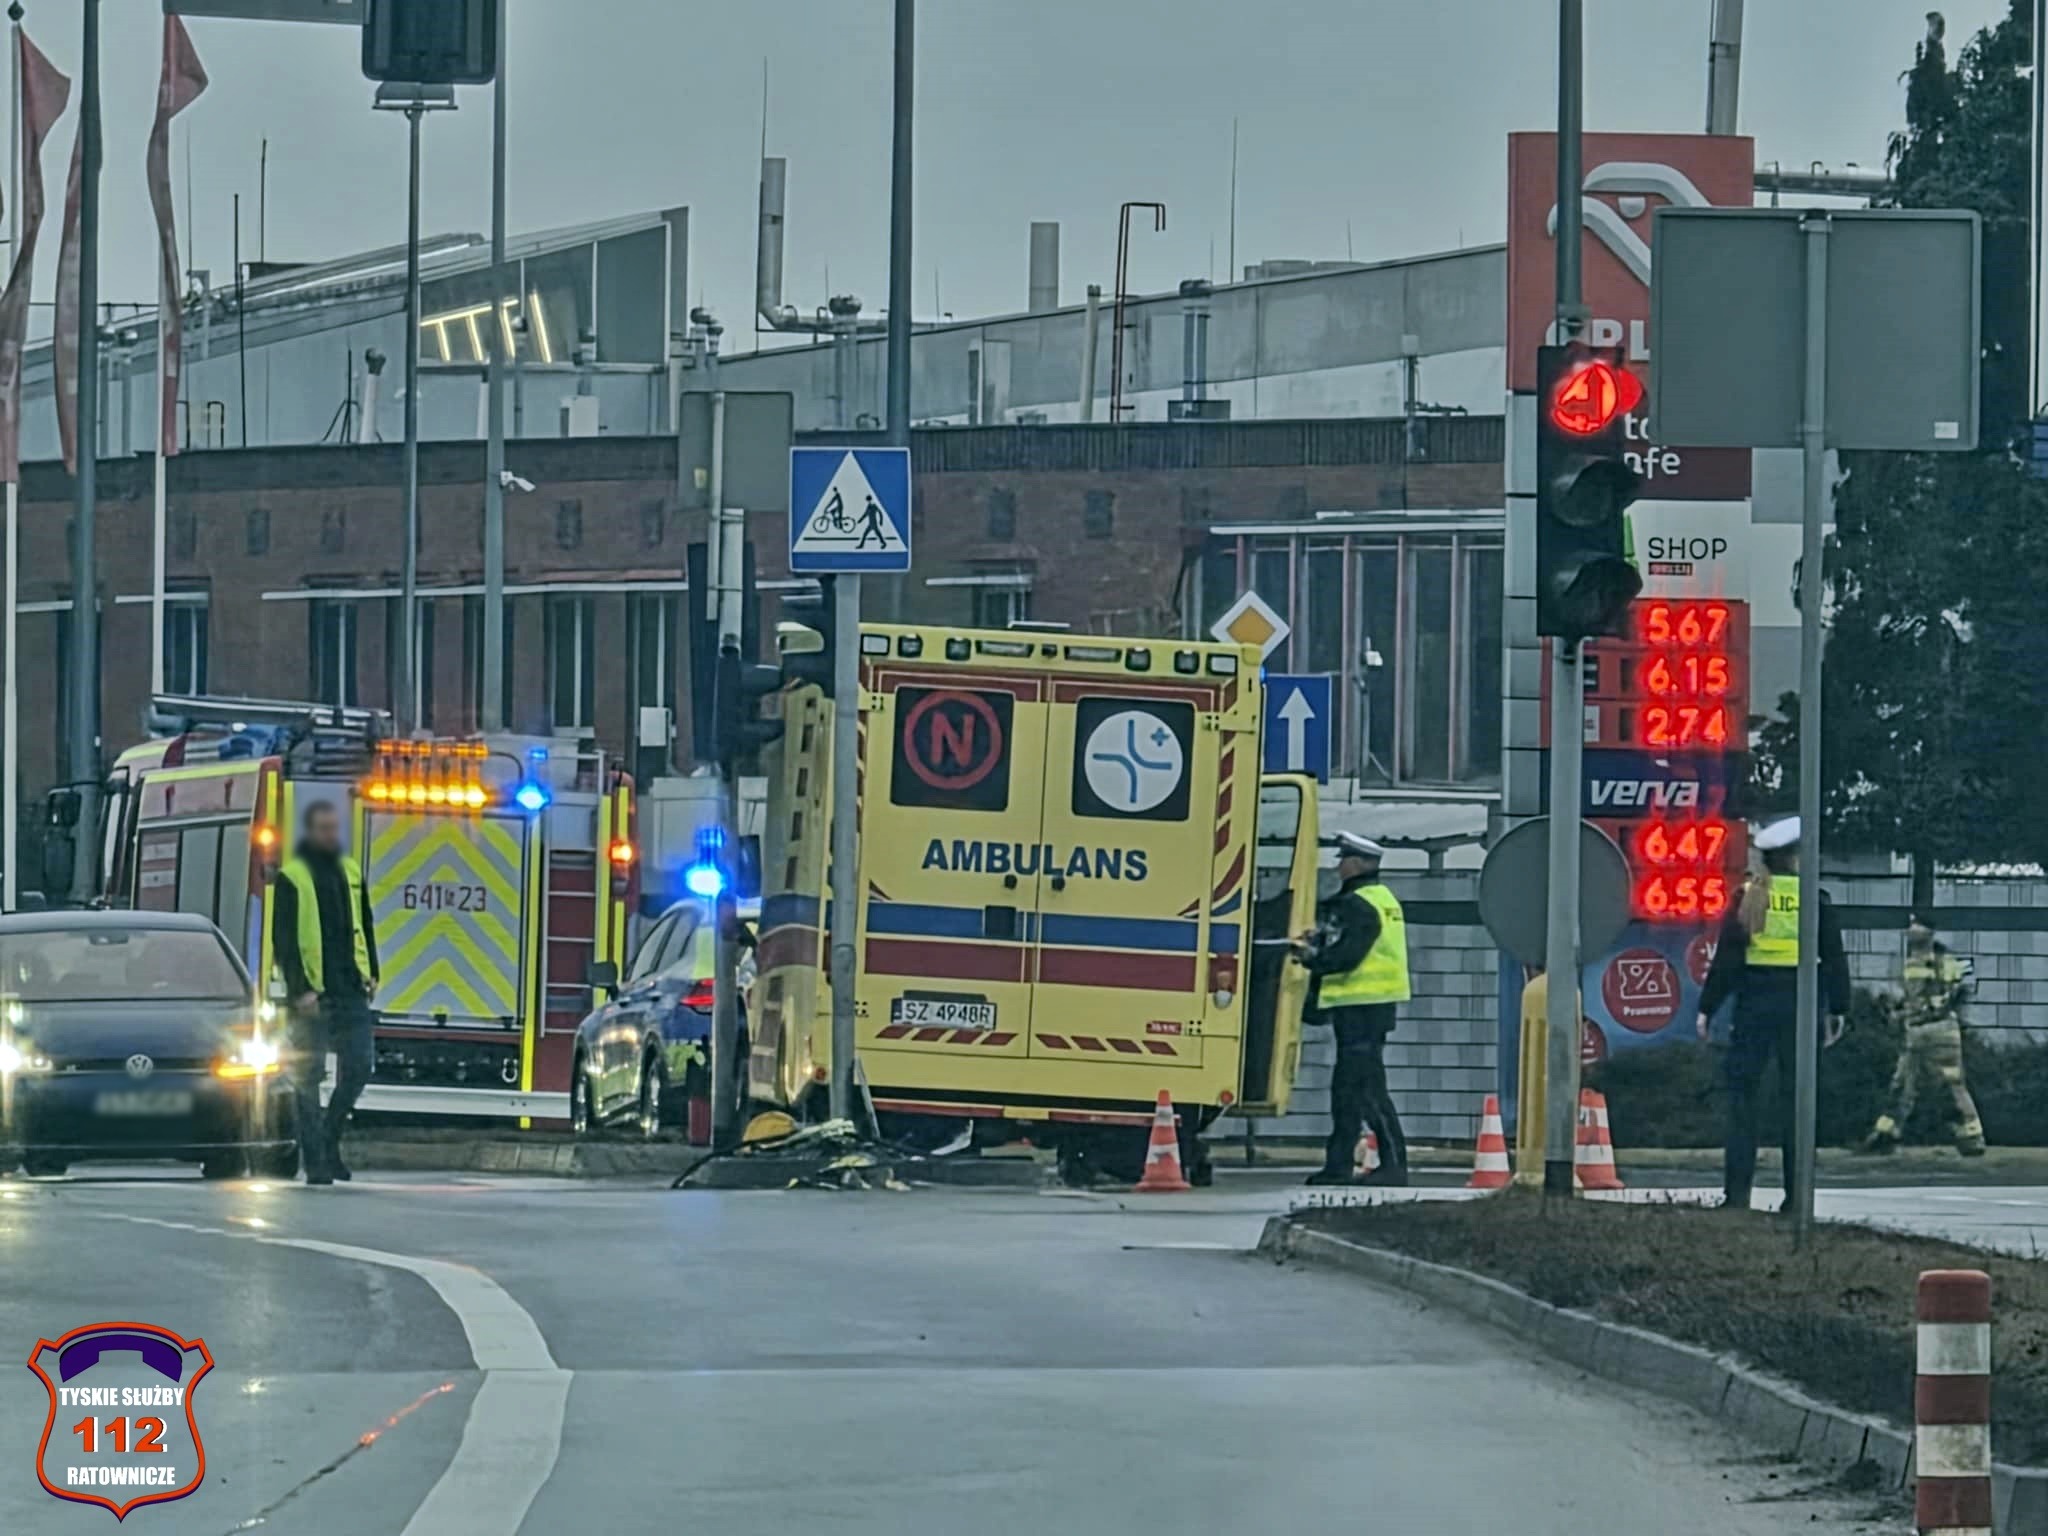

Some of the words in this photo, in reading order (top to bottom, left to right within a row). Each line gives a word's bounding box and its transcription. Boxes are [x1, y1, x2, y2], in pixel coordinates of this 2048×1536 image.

[1648, 537, 1728, 560] SHOP
[1648, 606, 1728, 646] 5.67
[1648, 656, 1728, 696] 6.15
[930, 711, 976, 768] N
[1646, 707, 1727, 745] 2.74
[1591, 779, 1700, 807] verva
[921, 838, 1149, 882] AMBULANS
[1644, 825, 1726, 864] 6.47
[1644, 876, 1726, 916] 6.55
[905, 1002, 929, 1021] SZ
